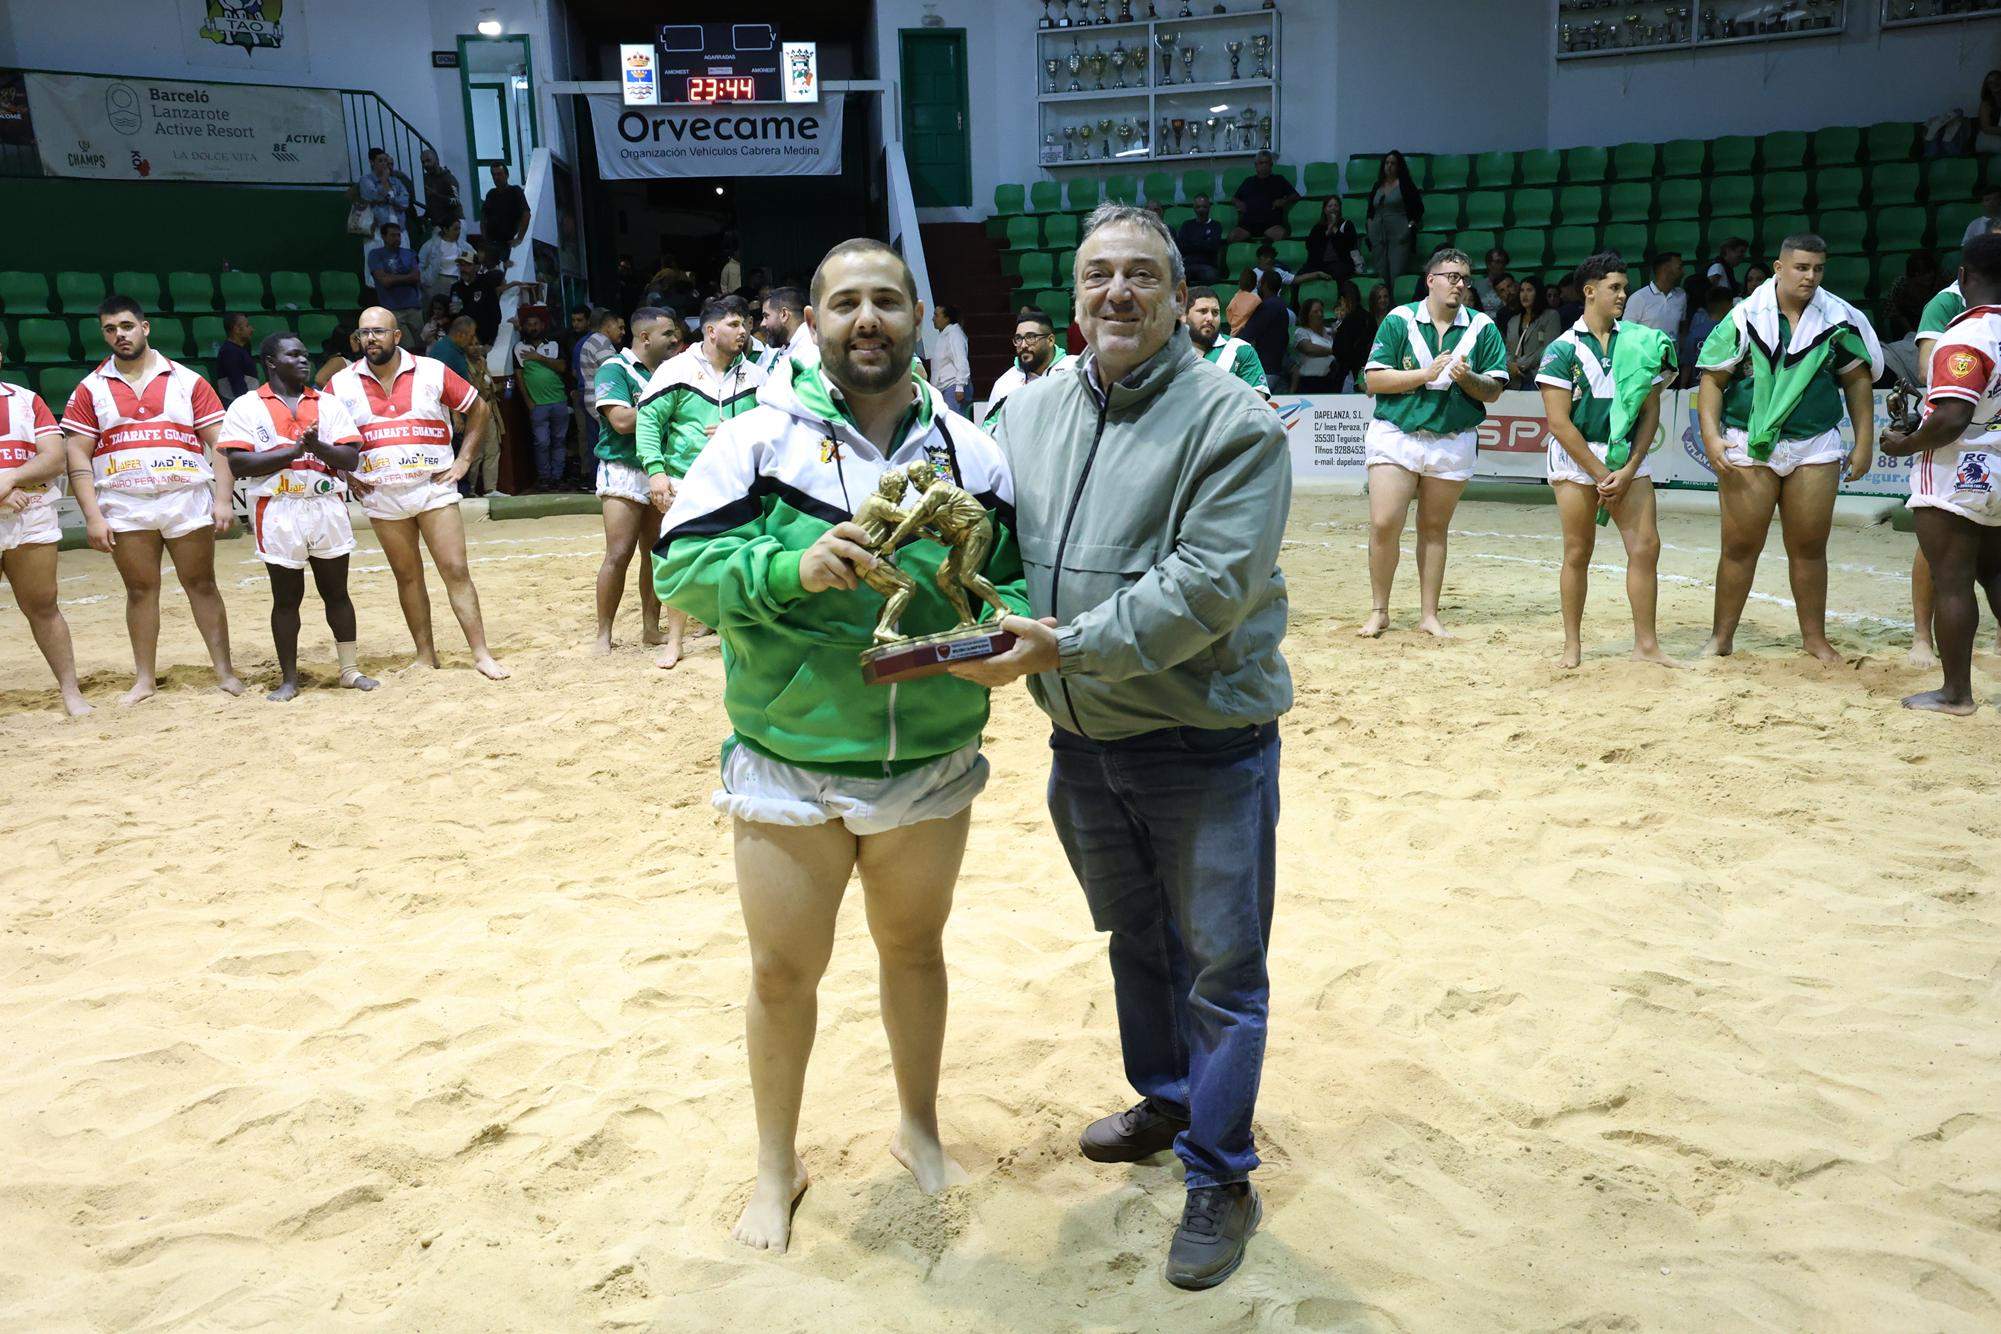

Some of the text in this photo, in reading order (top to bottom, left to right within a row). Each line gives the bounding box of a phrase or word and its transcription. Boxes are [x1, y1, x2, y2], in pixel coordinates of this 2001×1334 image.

[226, 19, 264, 31] TAO
[770, 33, 776, 41] V
[149, 88, 209, 103] Barceló
[690, 79, 752, 100] 23:44
[151, 105, 230, 121] Lanzarote
[155, 122, 255, 138] Active Resort
[617, 110, 820, 143] Orvecame
[285, 134, 327, 144] ACTIVE
[273, 143, 287, 152] BE
[620, 145, 820, 161] Organización Vehículos Cabrera Medina
[67, 153, 106, 169] CHAMPS
[173, 150, 258, 162] LA DOLCE VITA
[1963, 453, 1988, 462] RG
